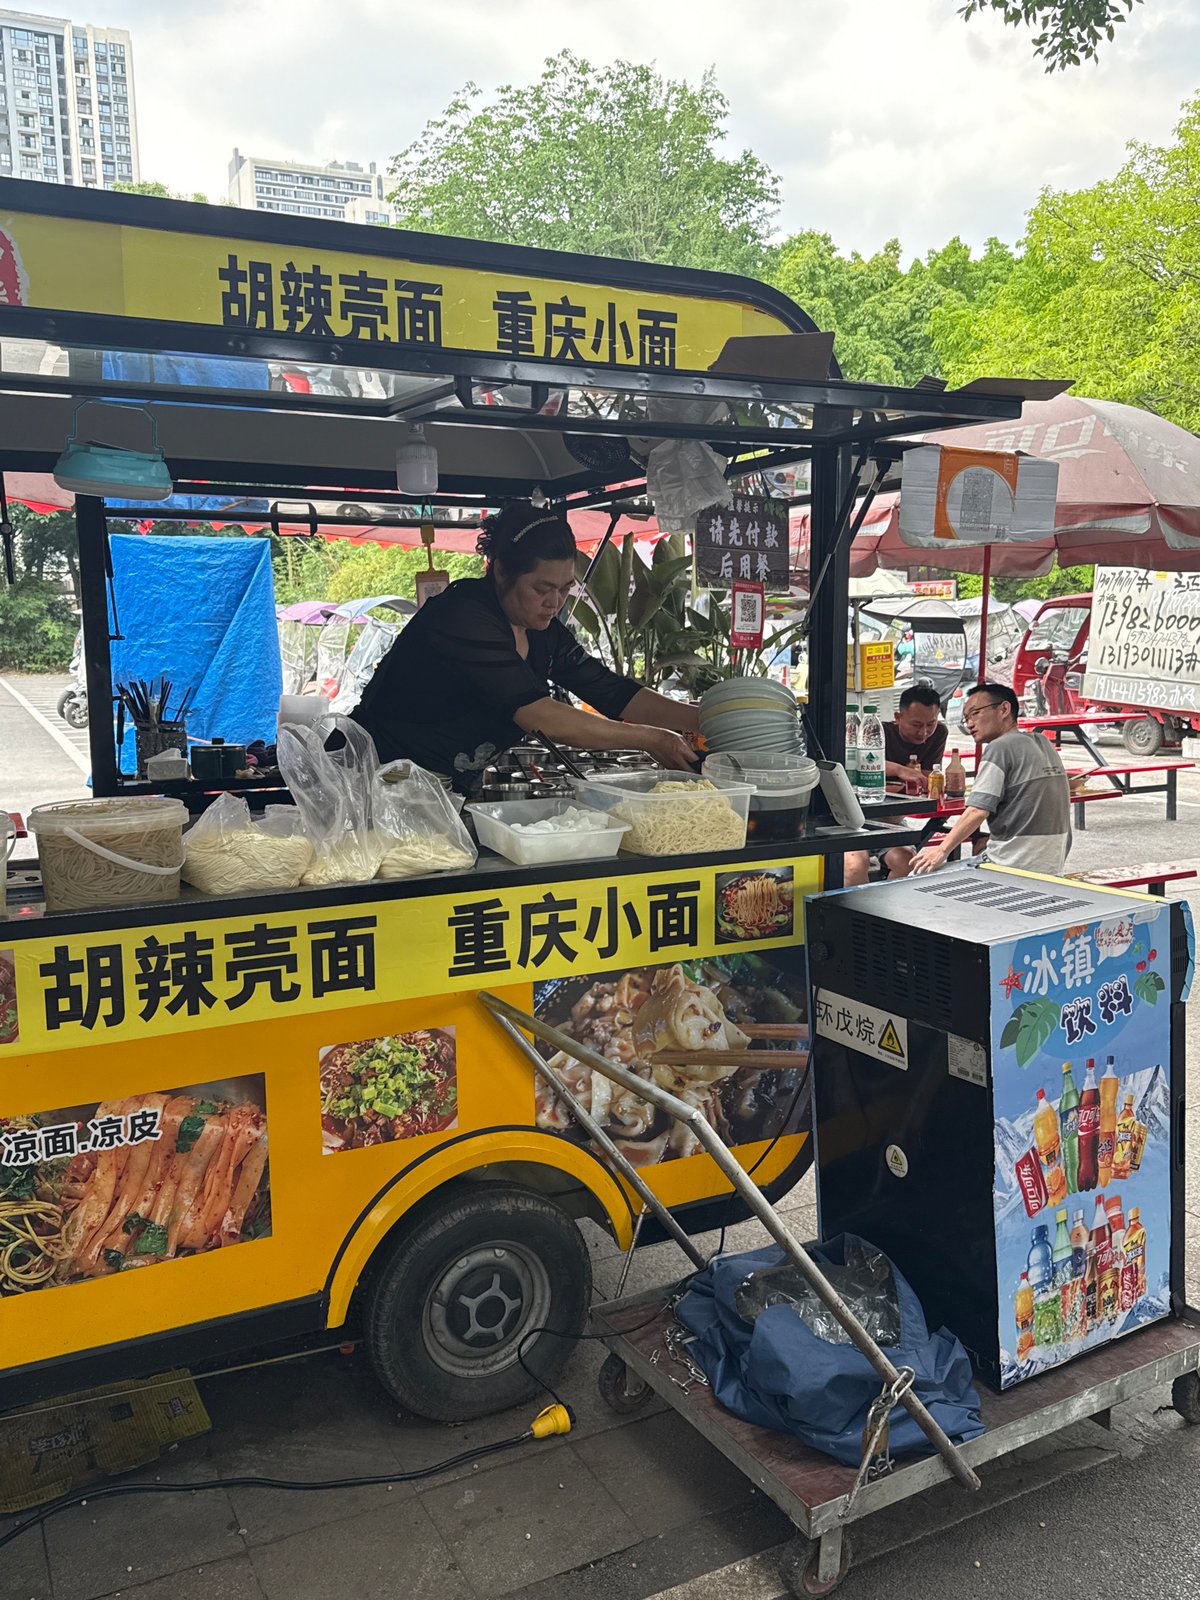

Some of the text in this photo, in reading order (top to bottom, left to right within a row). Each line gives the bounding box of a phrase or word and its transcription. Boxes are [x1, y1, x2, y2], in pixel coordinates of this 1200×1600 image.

[219, 254, 678, 369] 胡辣壳面 重庆小面
[709, 514, 779, 548] 请先付款
[719, 552, 771, 581] 后用餐
[39, 880, 701, 1031] 胡辣壳面 重庆小面
[1023, 935, 1095, 995] 冰镇
[815, 1000, 876, 1046] 环戊烷
[1060, 974, 1133, 1044] 饮料
[1020, 1161, 1040, 1211] 可口可乐
